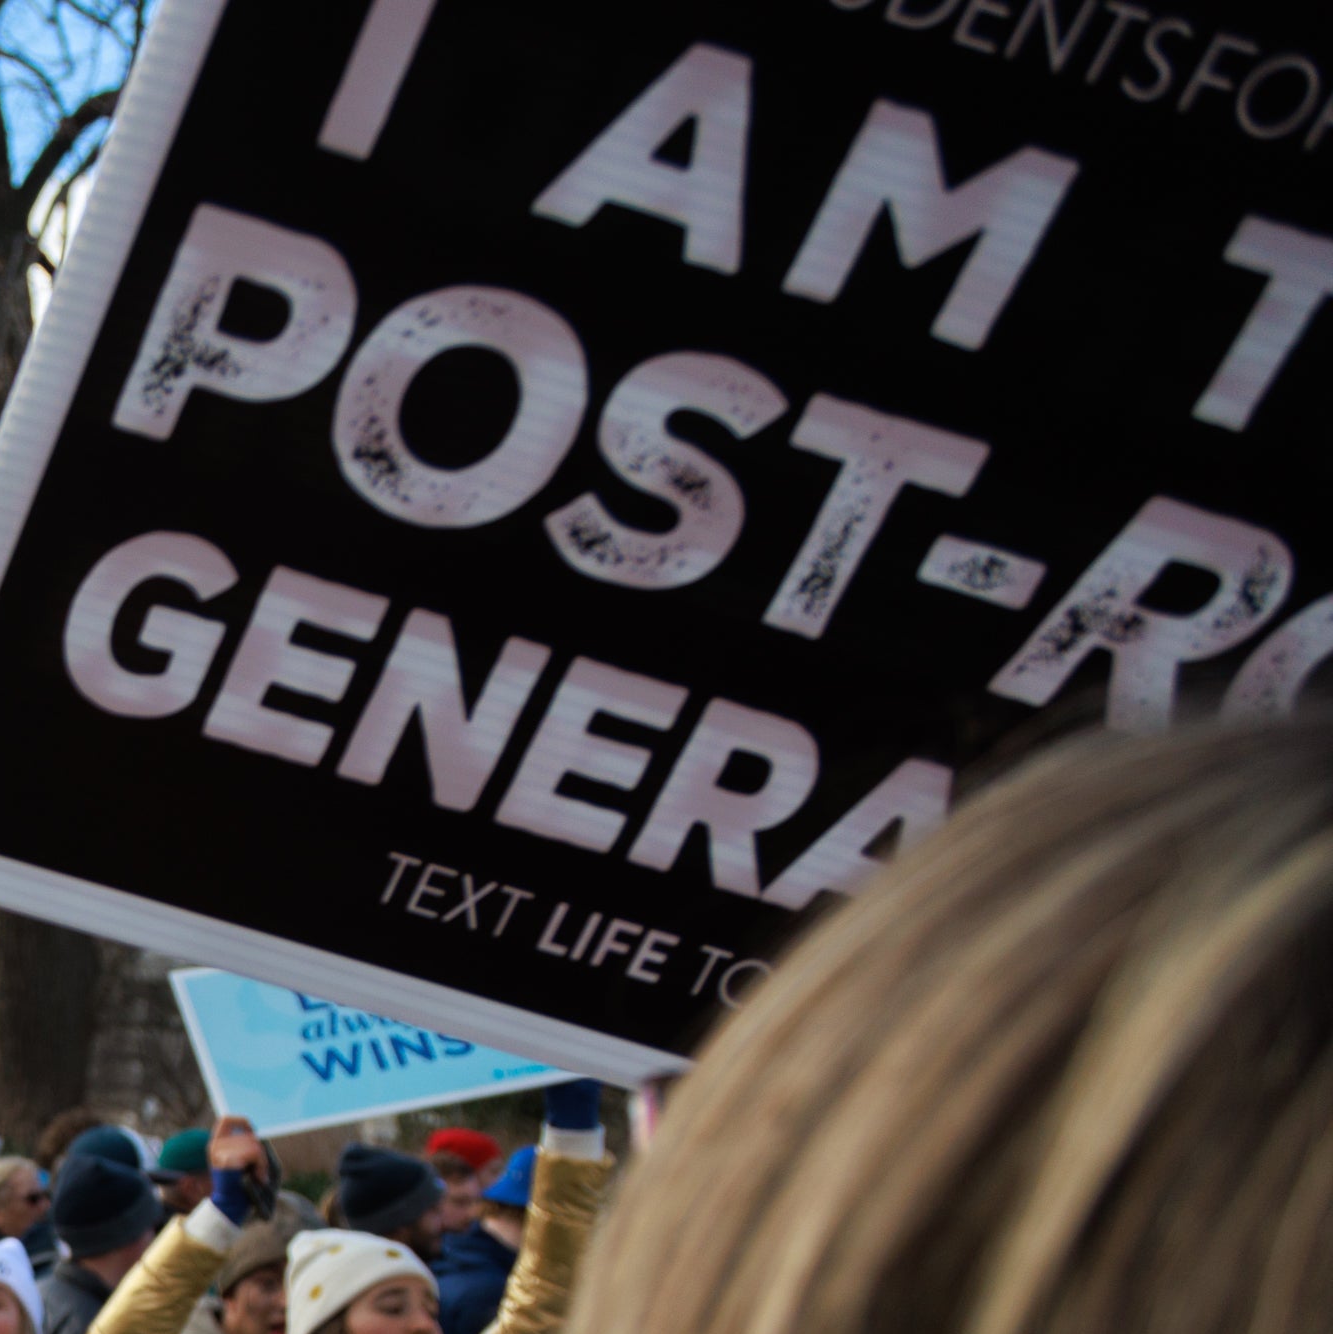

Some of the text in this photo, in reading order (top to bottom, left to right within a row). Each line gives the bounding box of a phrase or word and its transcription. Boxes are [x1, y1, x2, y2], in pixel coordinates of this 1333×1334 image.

[320, 0, 435, 158] I
[533, 46, 1076, 349] AM
[382, 852, 533, 936] TEXT
[537, 902, 680, 983] LIFE
[300, 1030, 476, 1082] WINS
